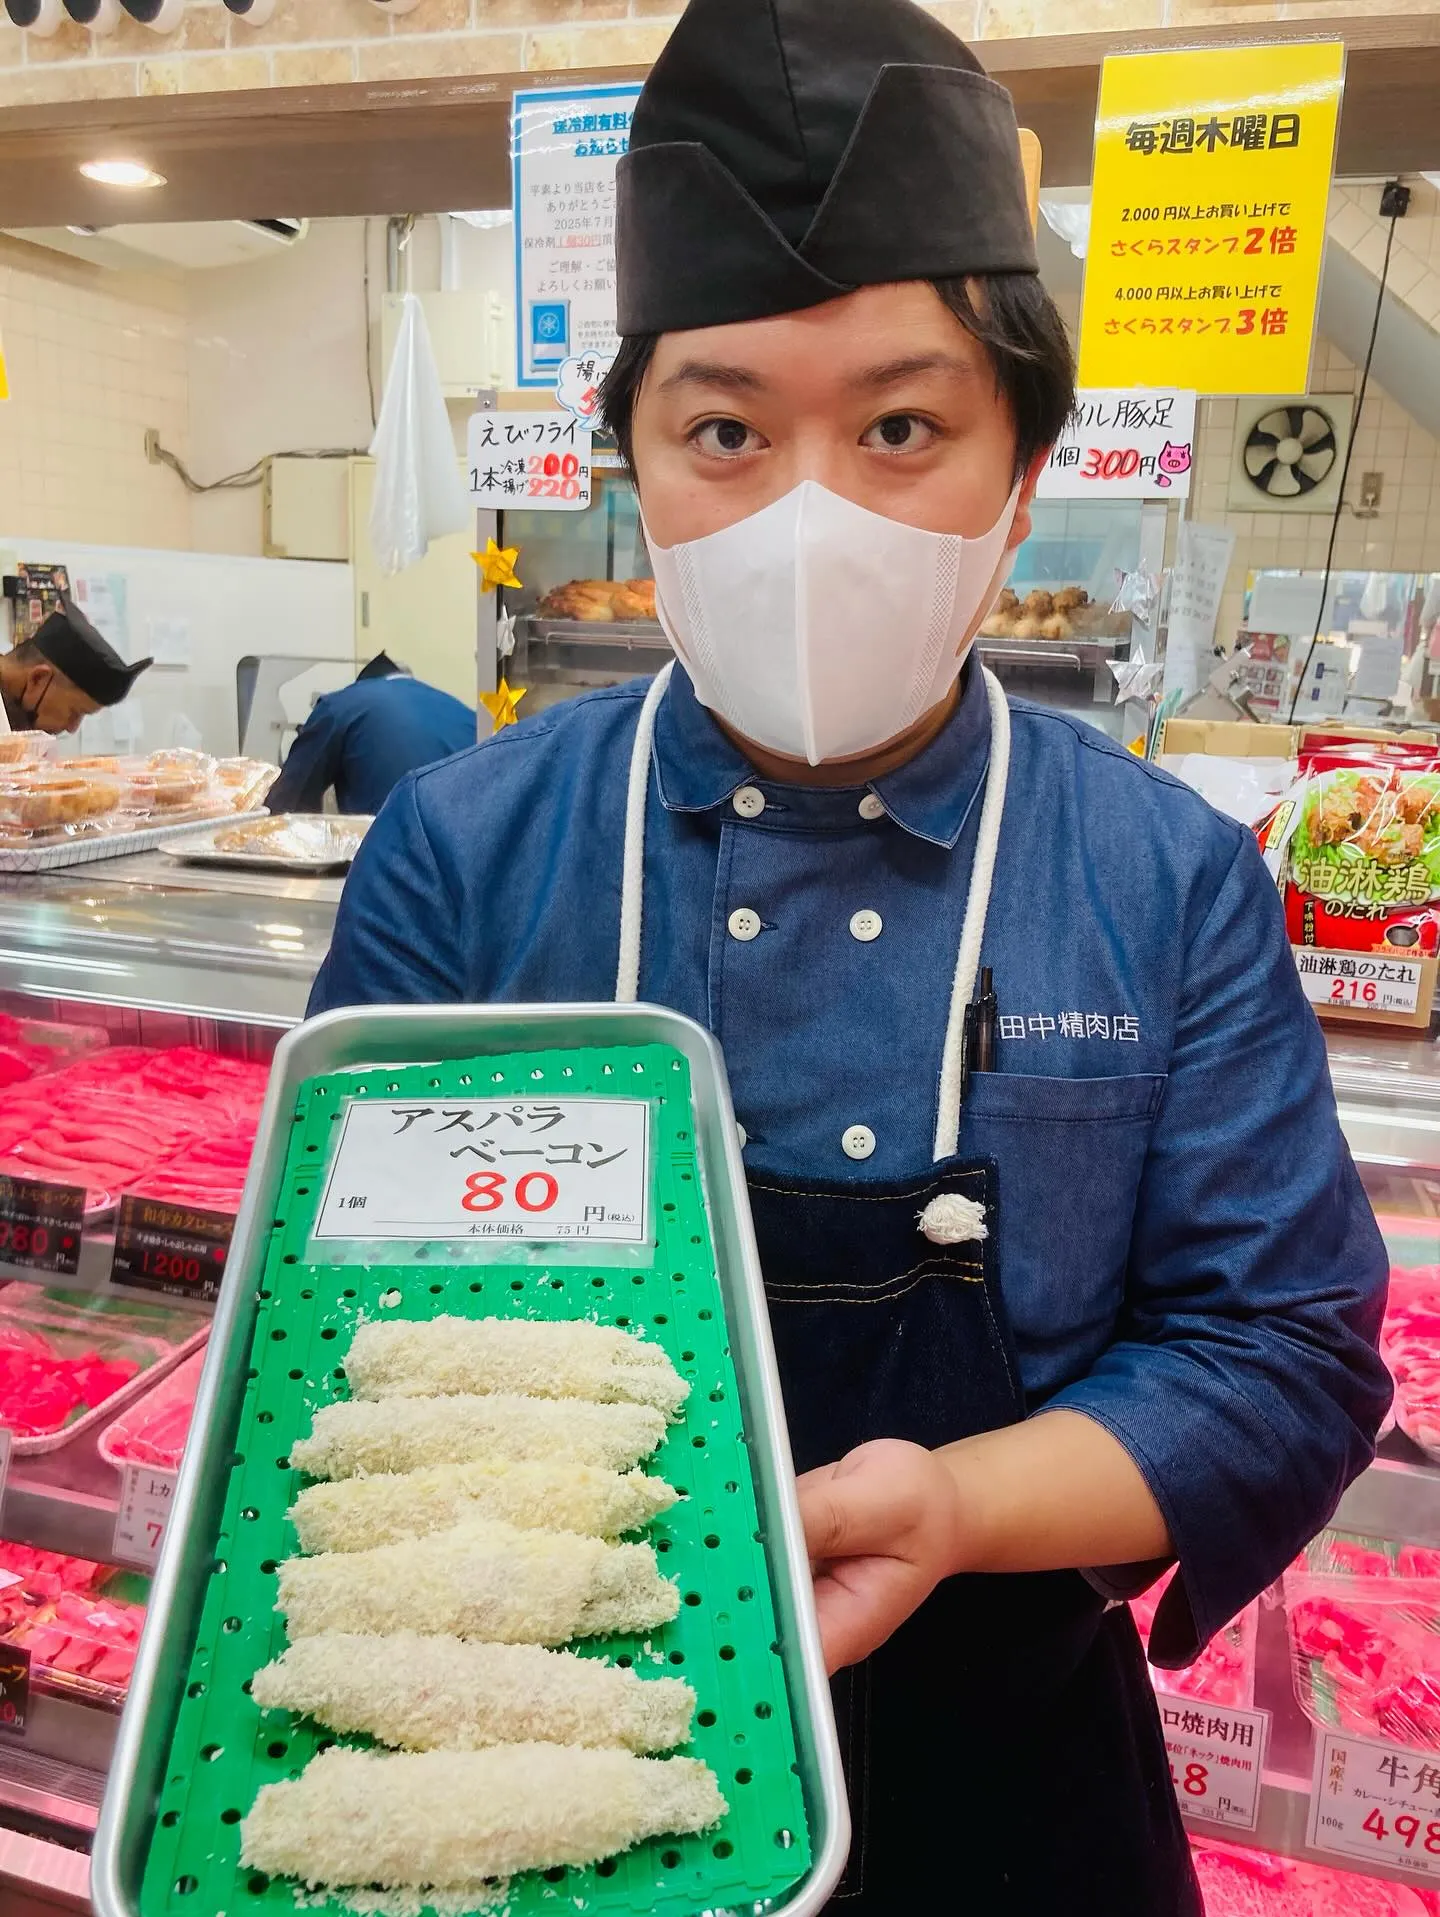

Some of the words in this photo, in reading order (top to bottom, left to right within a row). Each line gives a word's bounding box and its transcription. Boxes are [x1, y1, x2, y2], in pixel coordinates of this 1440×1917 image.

[1125, 114, 1300, 155] 毎週木曜日
[481, 419, 578, 447] えびフライ
[470, 467, 502, 492] 1本
[1298, 857, 1432, 904] 油淋鶏
[1325, 899, 1388, 921] のたれ
[1300, 955, 1416, 982] 油淋鶏のたれ
[1331, 979, 1377, 1002] 216
[999, 1011, 1140, 1042] 田中精肉店
[391, 1105, 566, 1135] アスパラ
[449, 1139, 628, 1169] ベーコン
[338, 1196, 367, 1209] 1個
[461, 1171, 559, 1212] 80
[468, 1224, 524, 1235] 本体価格
[143, 1250, 200, 1281] 1200
[1330, 1749, 1347, 1796] 国産牛
[1362, 1807, 1440, 1855] 498
